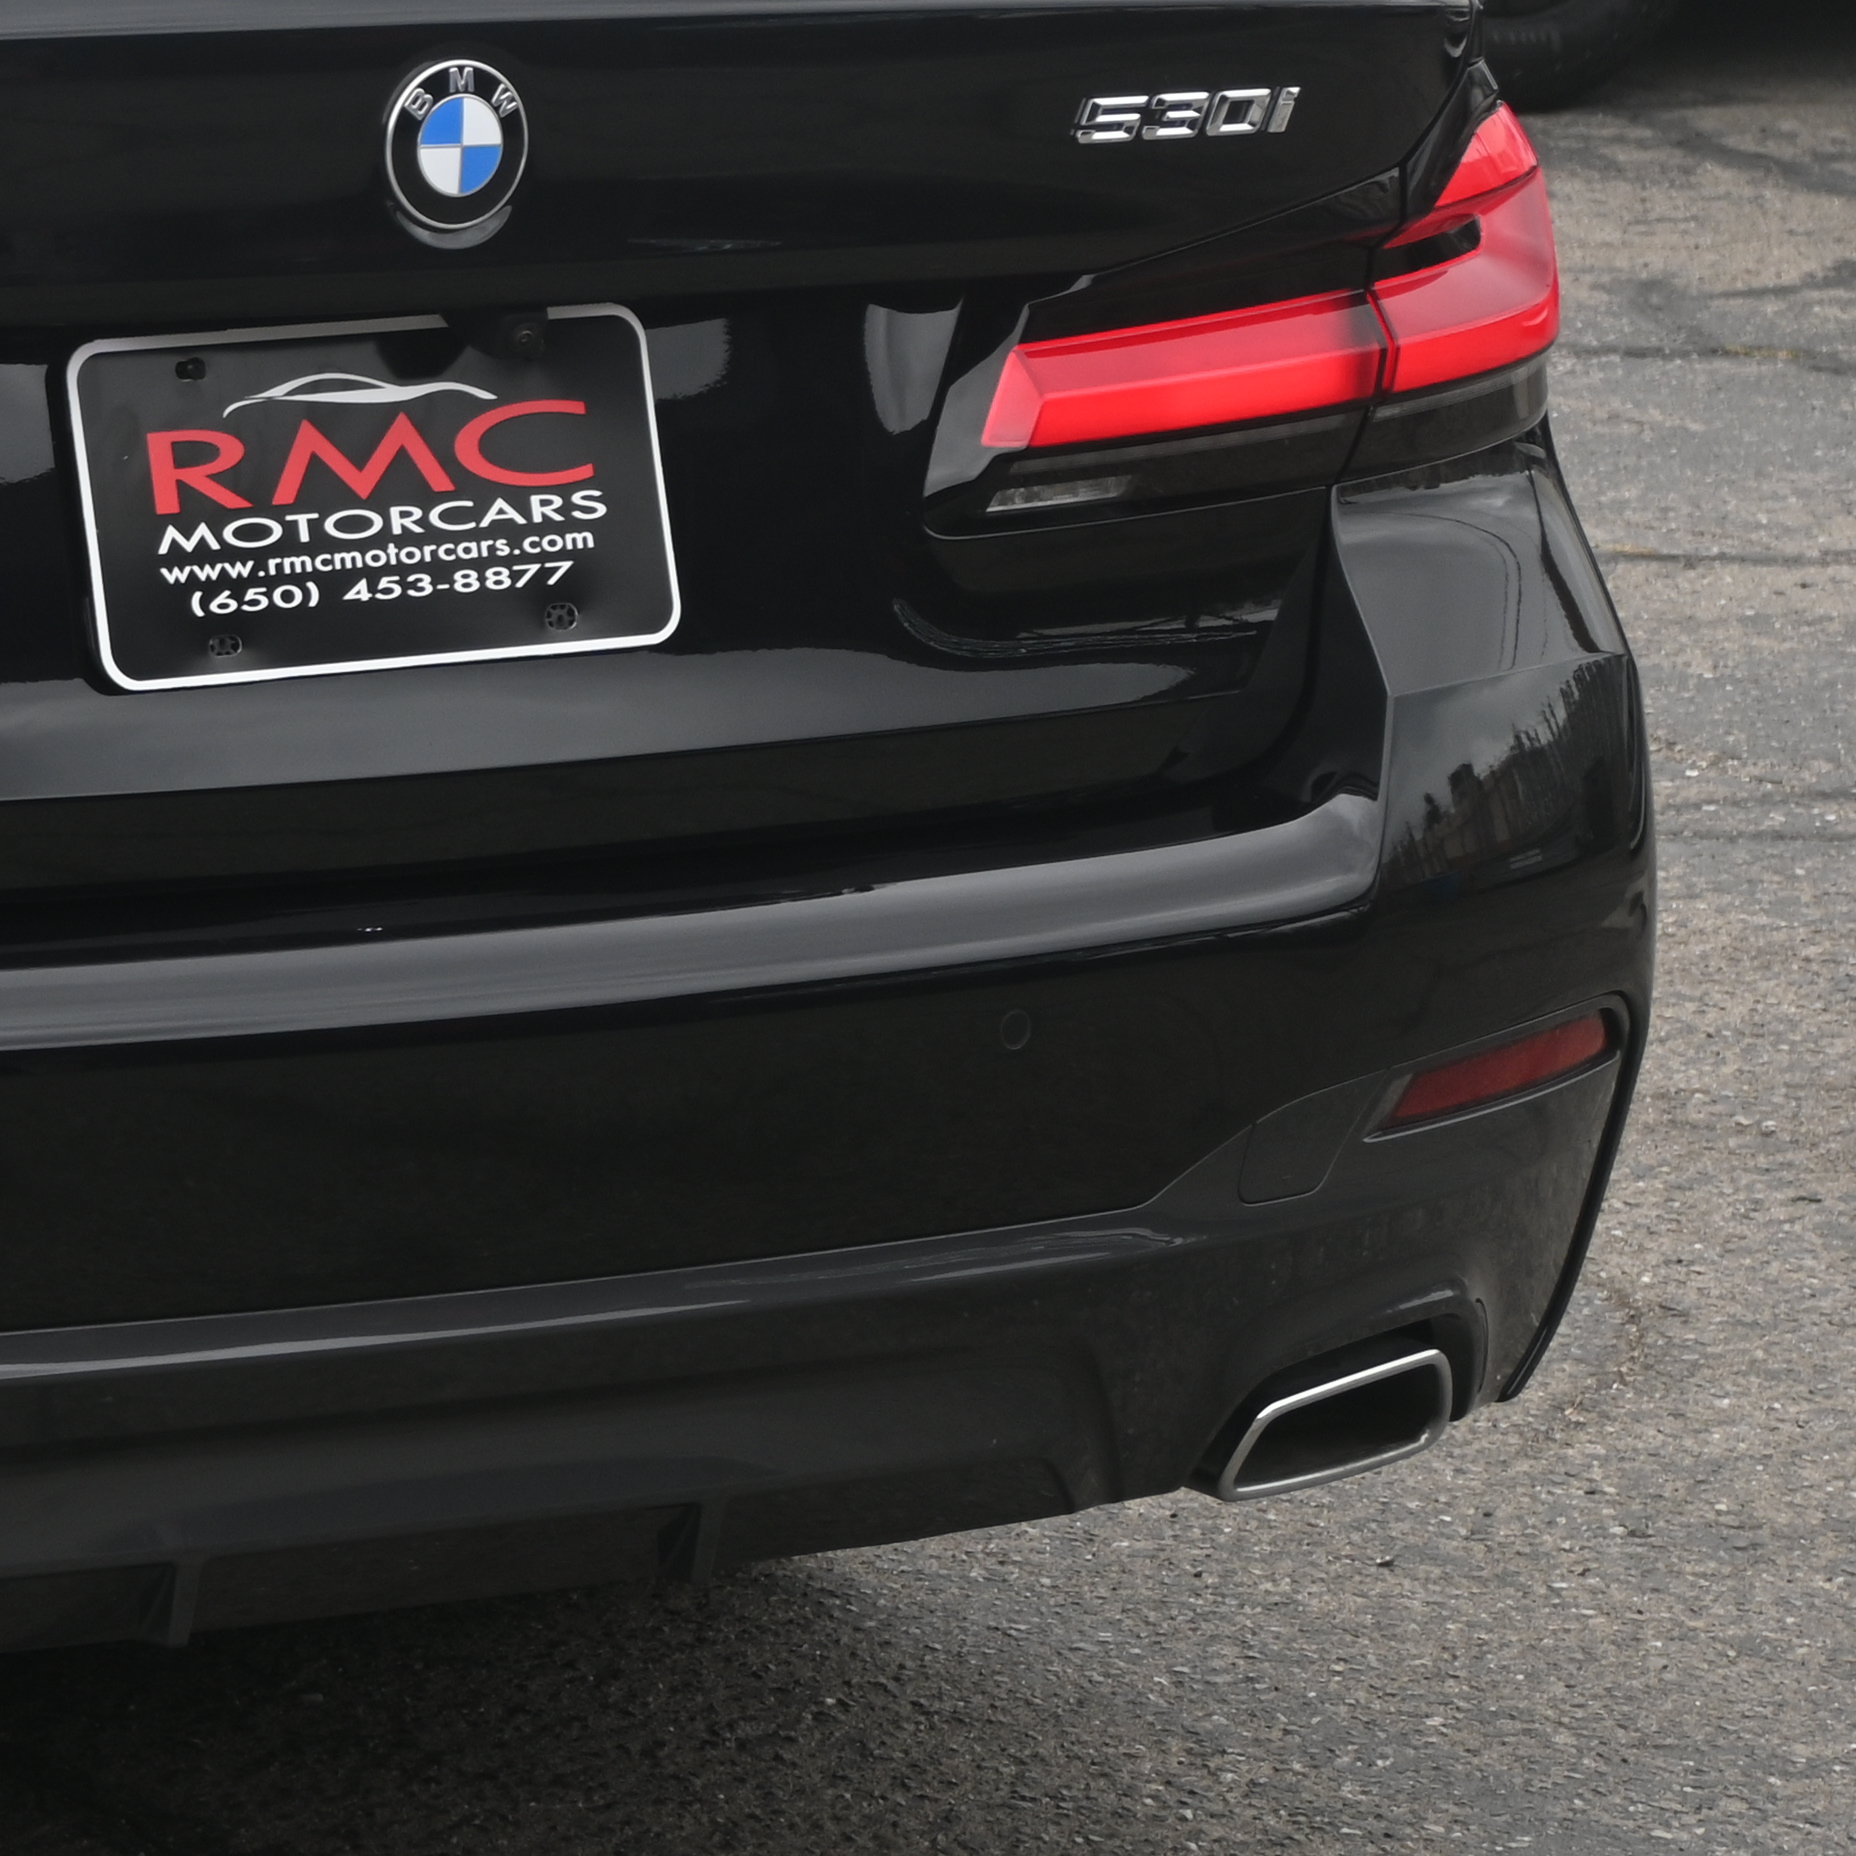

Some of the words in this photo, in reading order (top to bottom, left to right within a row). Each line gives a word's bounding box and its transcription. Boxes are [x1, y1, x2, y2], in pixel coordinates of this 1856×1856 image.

[404, 66, 518, 121] BMW
[1074, 85, 1302, 145] 530i
[146, 398, 595, 515] RMC
[157, 488, 608, 555] MOTORCARS
[159, 529, 595, 585] www.rmcmotorcars.com
[189, 580, 321, 617] (650)
[341, 559, 575, 604] 453-8877
